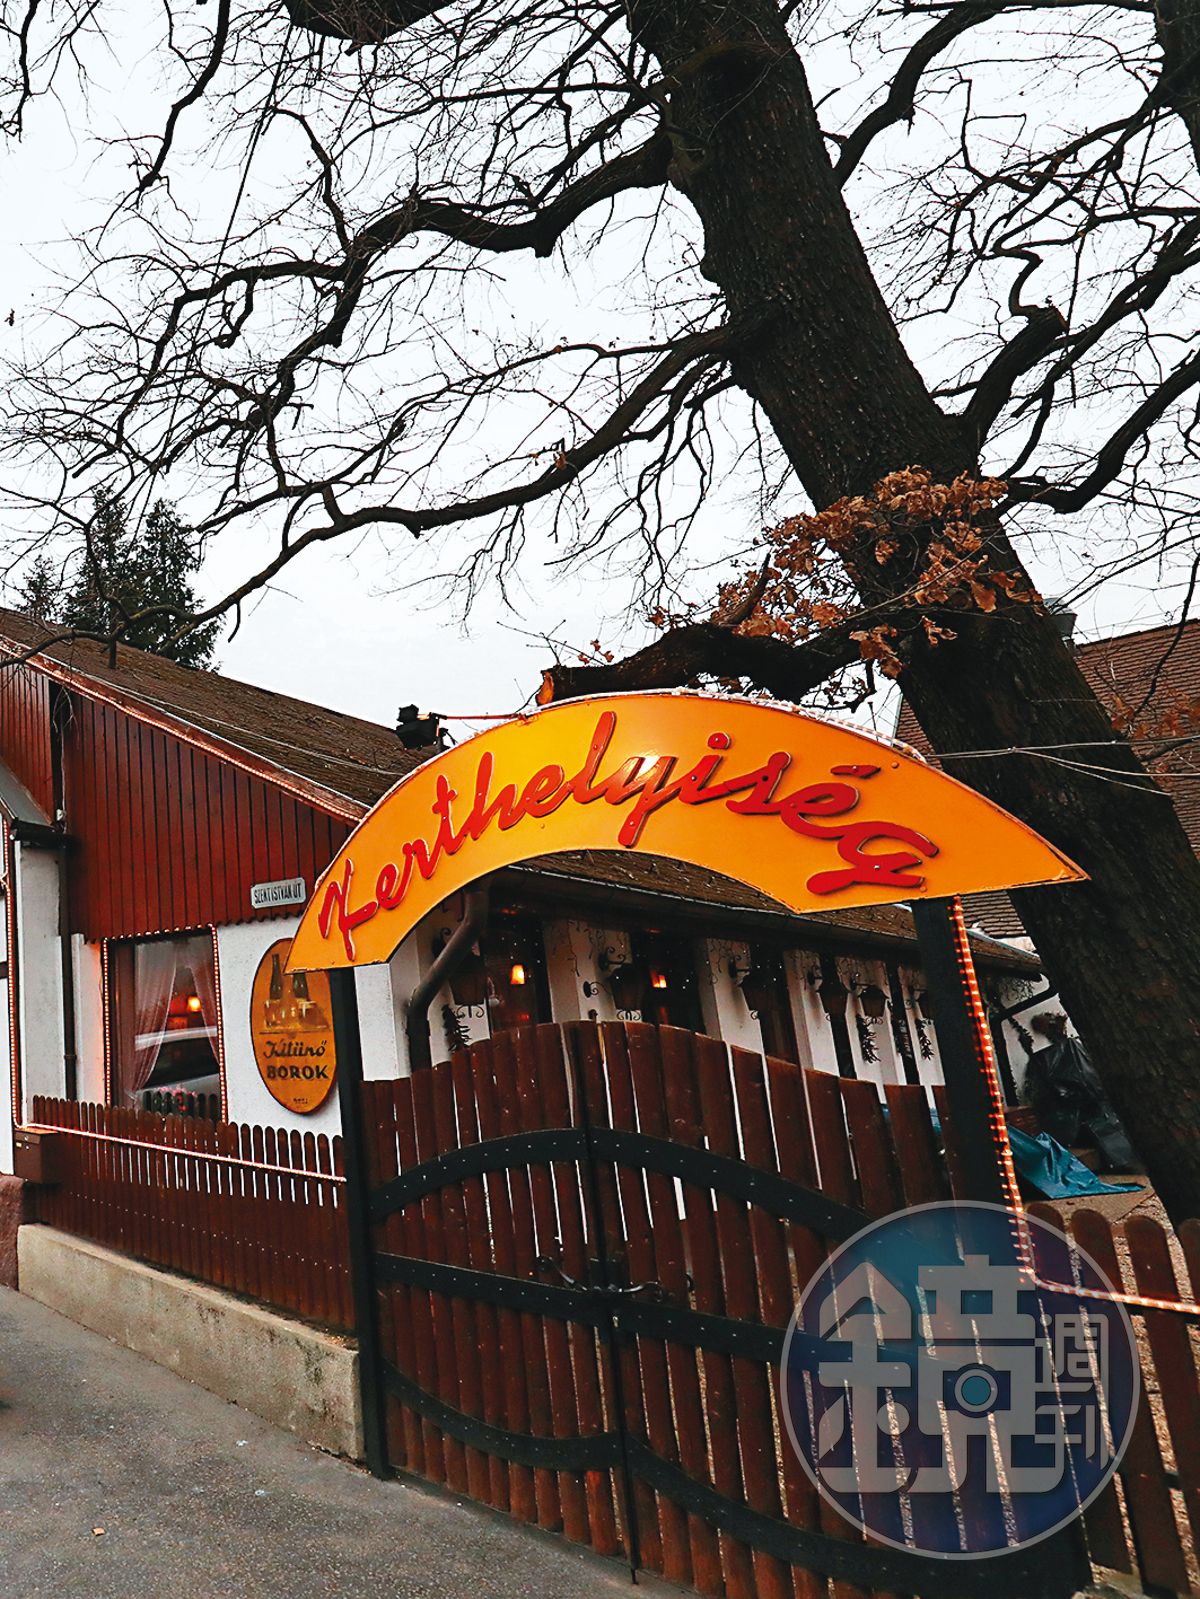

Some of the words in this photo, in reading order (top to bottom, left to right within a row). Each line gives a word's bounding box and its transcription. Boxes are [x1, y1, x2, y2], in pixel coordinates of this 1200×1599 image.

[318, 711, 939, 961] Kerthelyiség
[254, 888, 271, 904] SZENT
[266, 1065, 329, 1080] BOROK
